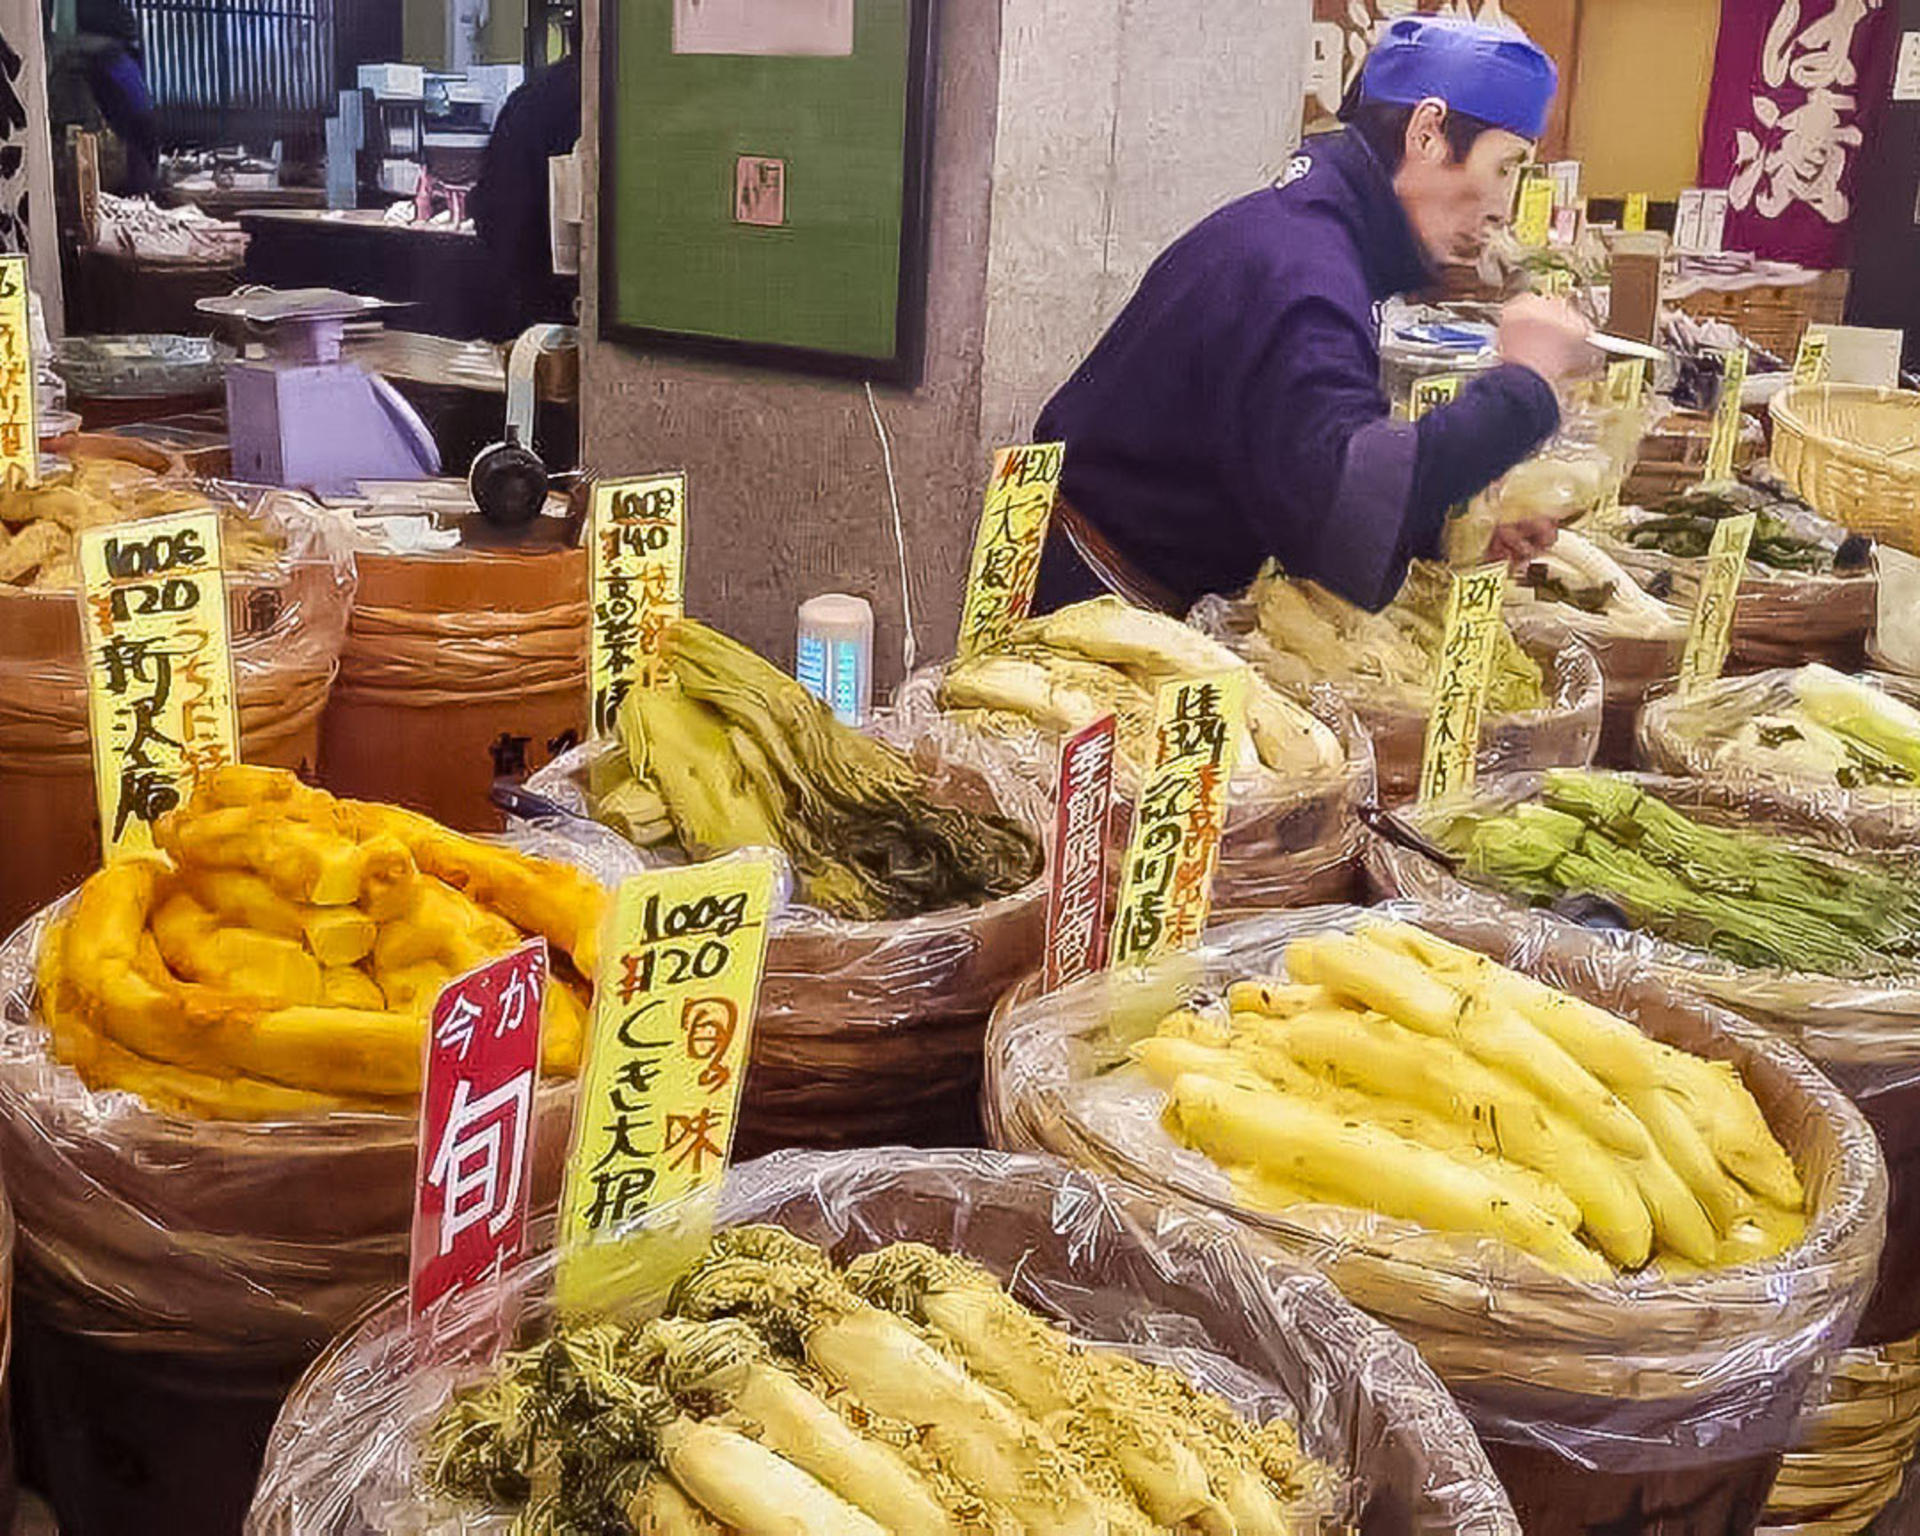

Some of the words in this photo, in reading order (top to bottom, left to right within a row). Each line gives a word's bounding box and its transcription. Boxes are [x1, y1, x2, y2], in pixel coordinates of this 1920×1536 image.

[105, 529, 206, 578] 100g
[640, 892, 748, 945] 100g
[620, 940, 730, 1005] ¥120
[427, 955, 546, 1061] 今が
[418, 1069, 535, 1256] 旬
